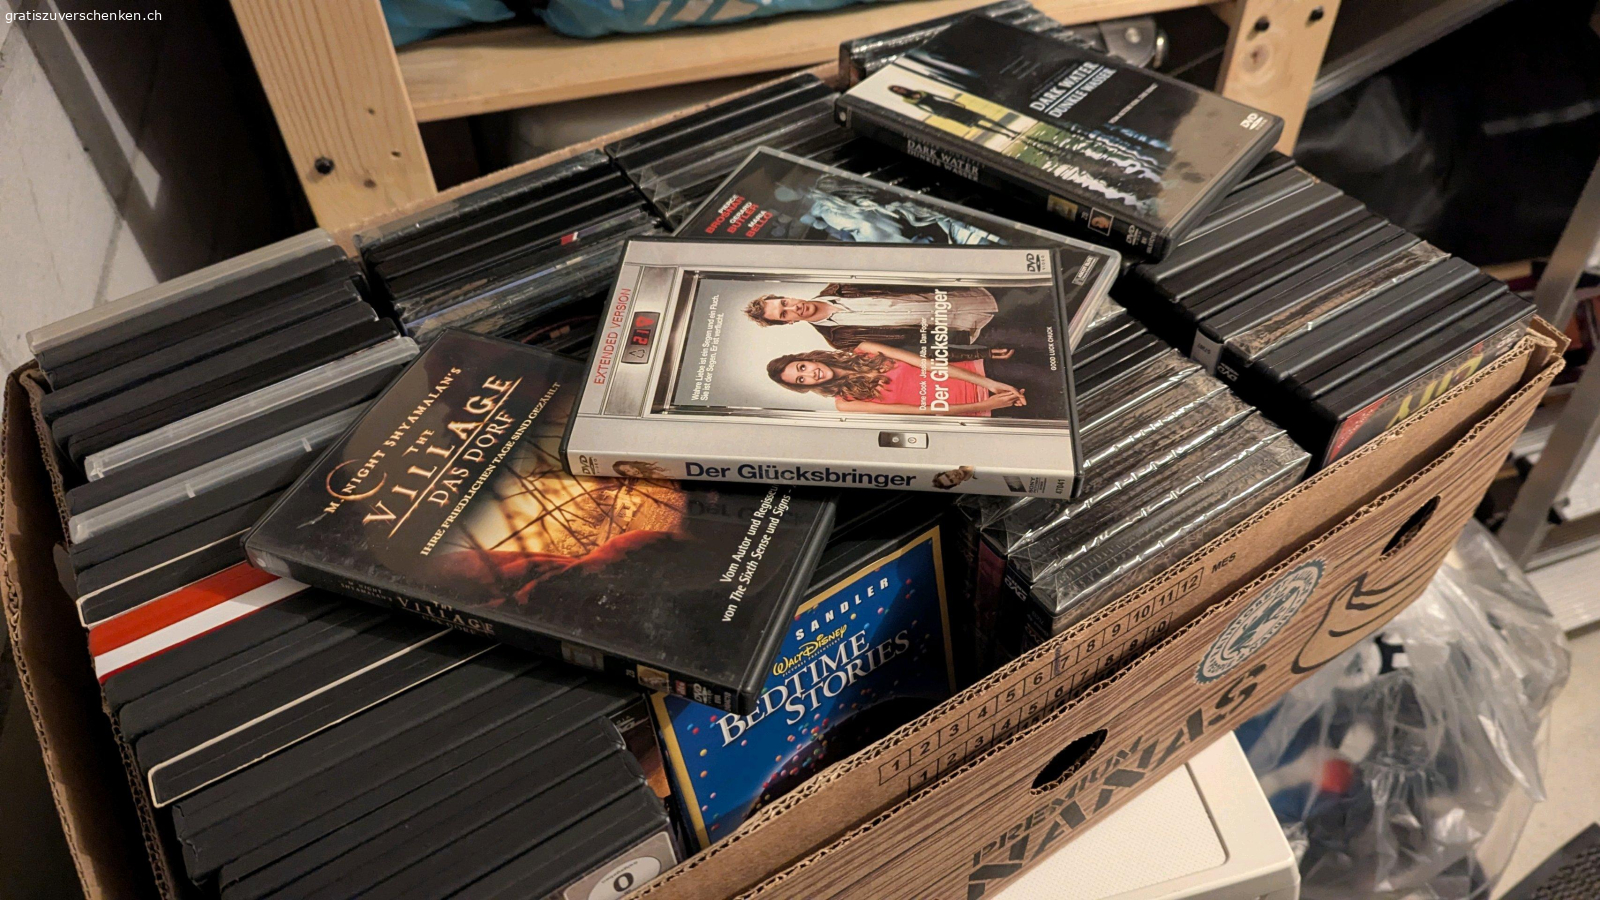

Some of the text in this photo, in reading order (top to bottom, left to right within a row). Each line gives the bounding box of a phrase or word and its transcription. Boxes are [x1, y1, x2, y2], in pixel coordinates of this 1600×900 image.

[1029, 84, 1067, 111] DARK
[1062, 61, 1100, 90] WATER
[1048, 87, 1088, 118] DUNKLE
[1085, 67, 1118, 92] WASSER
[1240, 113, 1258, 128] DVD
[907, 140, 937, 158] DARK
[941, 153, 979, 174] WATER
[705, 195, 745, 234] BROSNAN
[718, 194, 739, 213] PIERCE
[730, 201, 752, 223] GERARD
[727, 204, 759, 234] BUTLER
[745, 211, 773, 237] BELLO
[748, 210, 767, 227] MARIA
[1026, 253, 1036, 272] DVD
[594, 288, 631, 385] EXTENDED VERSION
[702, 330, 713, 348] Segen
[920, 332, 928, 344] Dan
[920, 347, 928, 359] Alba
[930, 289, 951, 412] Der Glücksbringer
[695, 366, 705, 381] Liebe
[691, 382, 702, 400] Wahre
[919, 381, 927, 396] Cook
[919, 396, 927, 411] Dane
[324, 366, 462, 514] M. NIGHT SHYAMALAN'S
[363, 375, 513, 525] VILLAGE
[402, 428, 434, 457] THE
[420, 381, 561, 556] IHRE FRIEDLICHEN TAGE SIND GEZÄHLT
[428, 409, 515, 507] DAS DORF
[579, 455, 591, 475] DVD
[685, 462, 916, 488] Der Glücksbringer
[1028, 476, 1036, 494] SONY
[1055, 478, 1066, 495] 47041
[773, 494, 791, 516] Signs
[766, 517, 780, 533] und
[719, 563, 739, 582] Vom
[732, 537, 752, 562] Autor
[747, 519, 762, 535] und
[751, 534, 771, 560] Sense
[739, 560, 759, 584] Sixth
[1211, 552, 1237, 574] MES
[729, 584, 747, 601] The
[397, 597, 496, 635] VILLAGE
[722, 605, 738, 622] von
[795, 577, 889, 642] SANDLER
[785, 630, 910, 725] STORIES
[891, 575, 1199, 771] 1 2 3 4 5 6 7 8 9 10 11 12
[716, 630, 870, 748] BEDTIME
[919, 771, 928, 781] 1
[947, 752, 957, 765] 2
[975, 735, 984, 748] 3
[1002, 719, 1011, 730] 4
[1028, 701, 1038, 713] 5
[1054, 685, 1064, 698] 6
[1080, 669, 1091, 681] 7
[1151, 620, 1167, 635] 10
[973, 735, 1142, 868] PREMIUM
